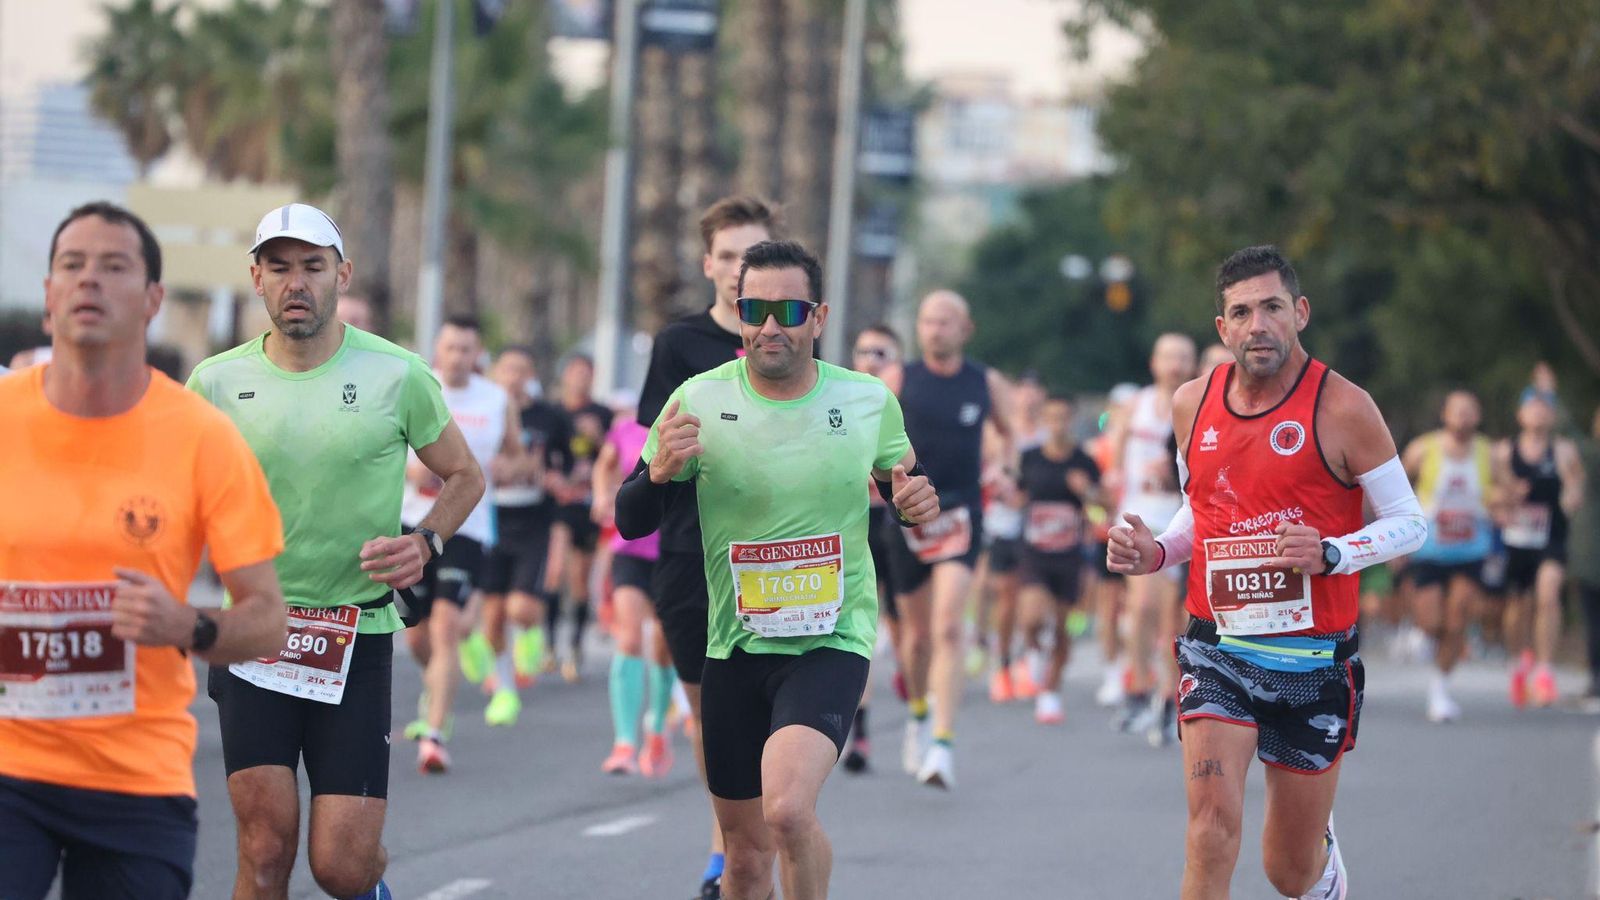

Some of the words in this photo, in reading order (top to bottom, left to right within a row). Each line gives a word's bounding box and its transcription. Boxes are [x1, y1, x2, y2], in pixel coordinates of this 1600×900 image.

[1229, 506, 1303, 534] CORREDORES
[760, 539, 834, 560] GENERALI
[1229, 541, 1277, 557] GENER
[758, 573, 821, 594] 17670
[1225, 571, 1286, 592] 10312
[24, 588, 111, 610] GENERAL
[1237, 592, 1250, 600] MIS
[1251, 590, 1274, 599] NIÑAS
[287, 607, 351, 624] ENERALI
[814, 610, 831, 619] 21K
[1278, 608, 1294, 616] 21K
[18, 630, 103, 659] 17518
[286, 632, 328, 655] 690
[279, 649, 302, 660] FABIO
[307, 675, 326, 685] 21K
